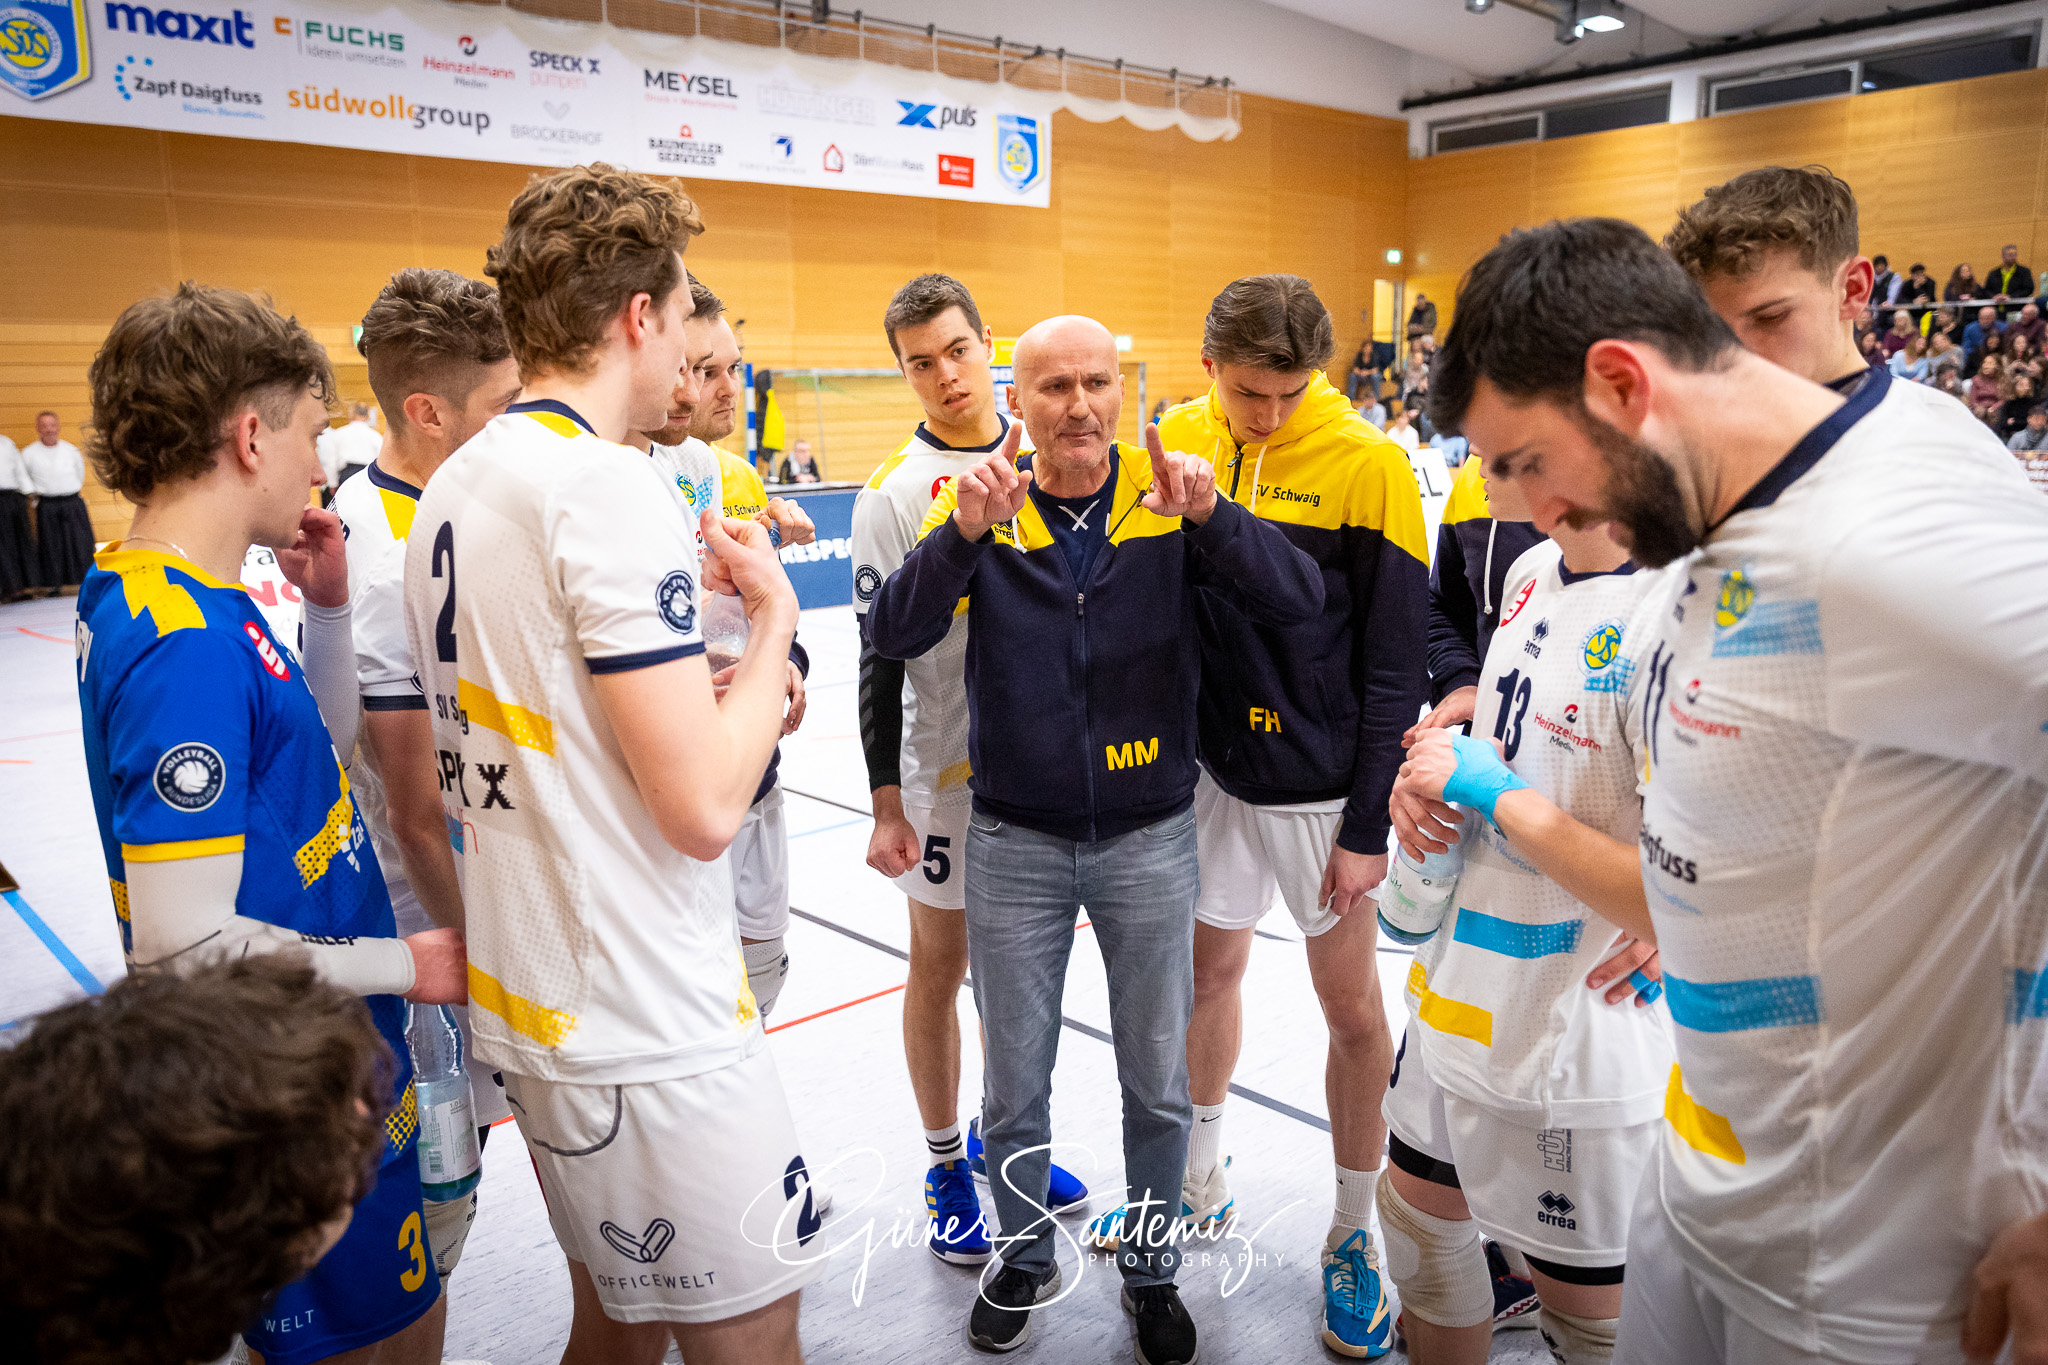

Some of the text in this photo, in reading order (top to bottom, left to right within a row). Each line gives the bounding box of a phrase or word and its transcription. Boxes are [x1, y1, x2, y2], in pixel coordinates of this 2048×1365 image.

[105, 2, 255, 49] maxit
[305, 20, 405, 52] FUCHS
[423, 55, 516, 81] Heinzelmann
[529, 50, 582, 72] SPECK
[134, 76, 263, 105] Zapf Daigfuss
[643, 68, 738, 99] MEYSEL
[657, 151, 716, 167] SERVICES
[1272, 486, 1321, 507] Schwaig
[431, 521, 457, 662] 2
[1249, 707, 1282, 733] FH
[1494, 668, 1532, 761] 13
[1535, 712, 1602, 754] Heinzelmann
[162, 749, 218, 775] VOLLEYBALL
[1106, 737, 1159, 771] MM
[163, 782, 218, 805] BUNDESLIGA
[922, 836, 951, 885] 5
[783, 1155, 822, 1247] 2
[1538, 1211, 1577, 1231] errea
[397, 1211, 427, 1292] 3
[597, 1271, 716, 1291] OFFICEWELT
[264, 1309, 315, 1333] WELT
